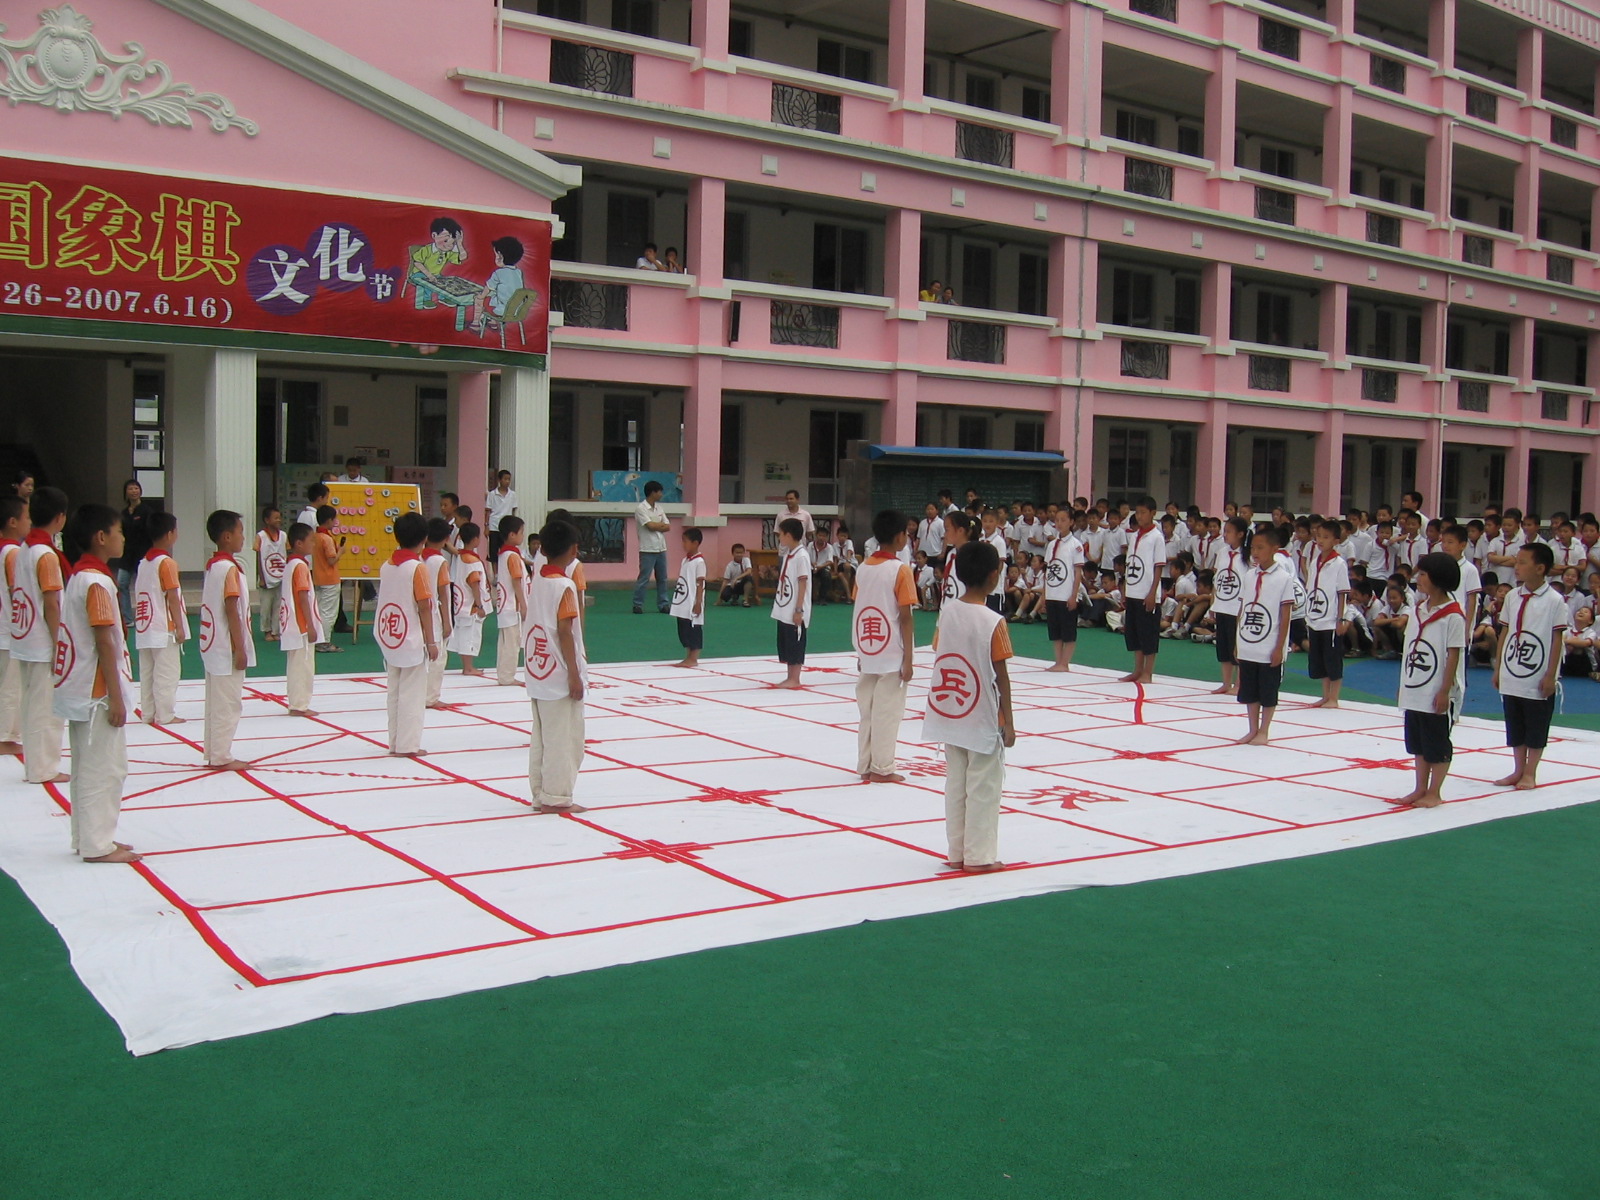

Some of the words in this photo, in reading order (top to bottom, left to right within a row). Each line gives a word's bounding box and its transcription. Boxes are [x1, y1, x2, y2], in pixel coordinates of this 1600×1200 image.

[256, 226, 394, 304] 文化节
[268, 558, 285, 574] 兵
[381, 611, 403, 640] 炮
[860, 615, 886, 647] 車
[1240, 611, 1266, 636] 馬
[528, 636, 550, 670] 馬
[1507, 639, 1538, 671] 炮
[931, 667, 972, 707] 兵
